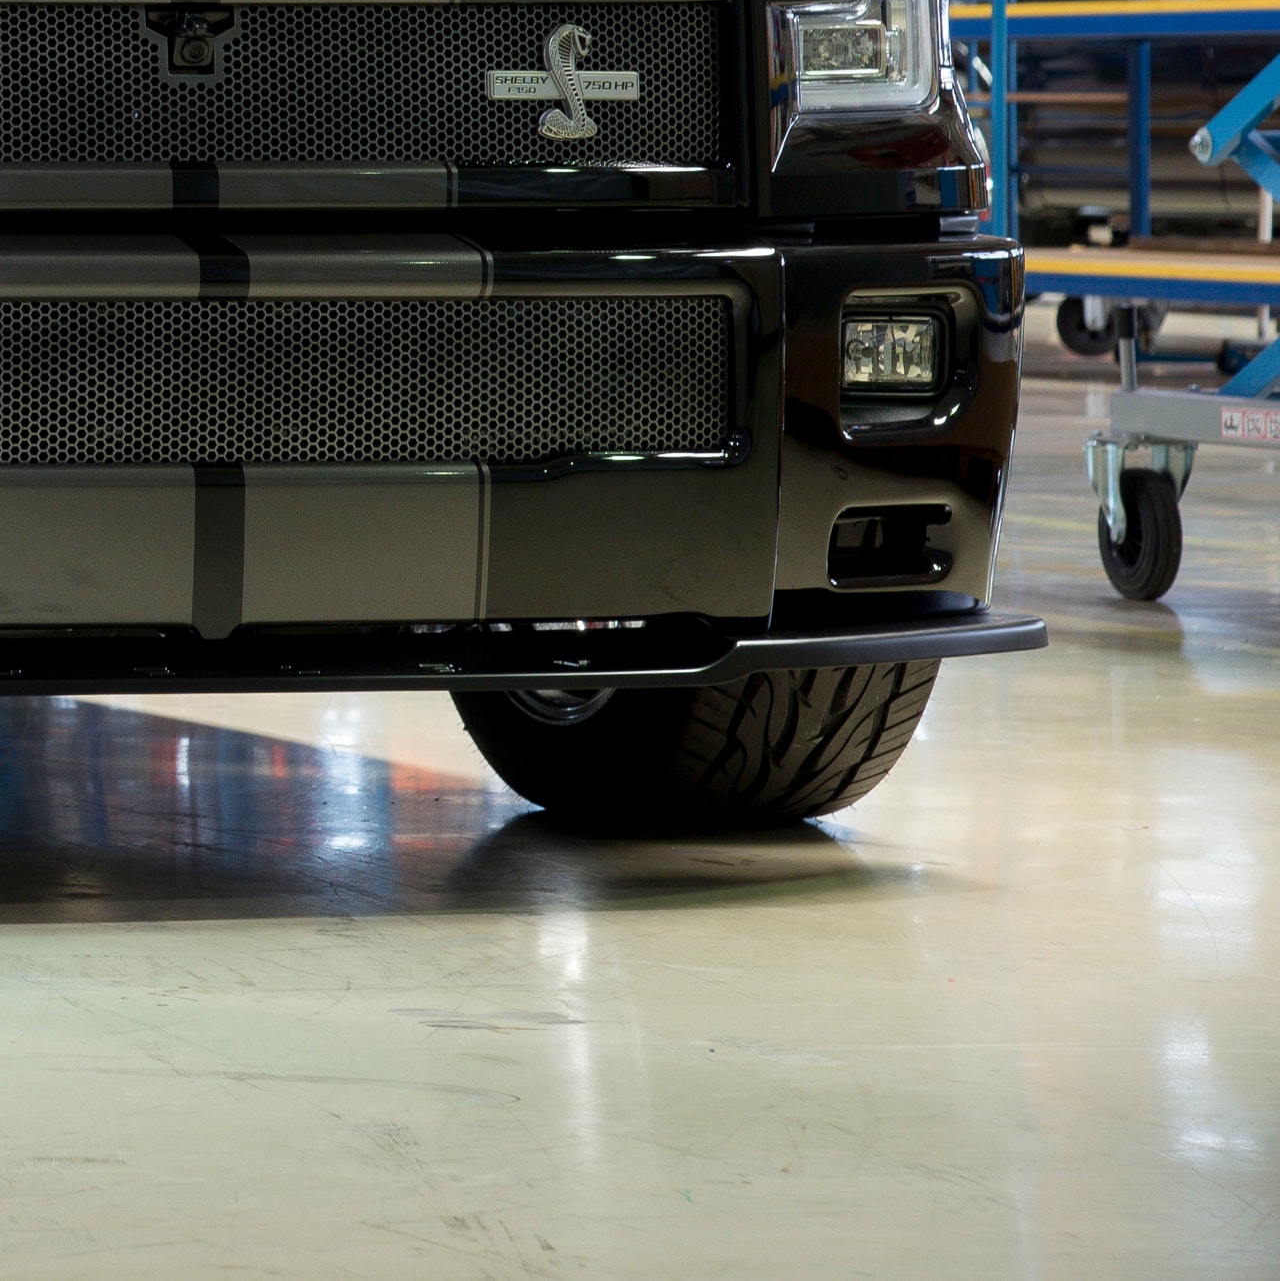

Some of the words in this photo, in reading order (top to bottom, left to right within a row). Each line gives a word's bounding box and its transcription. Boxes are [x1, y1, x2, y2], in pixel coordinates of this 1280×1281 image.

[495, 75, 550, 85] SHELBY
[582, 80, 612, 91] 750
[614, 81, 635, 91] HP
[507, 86, 537, 95] F150
